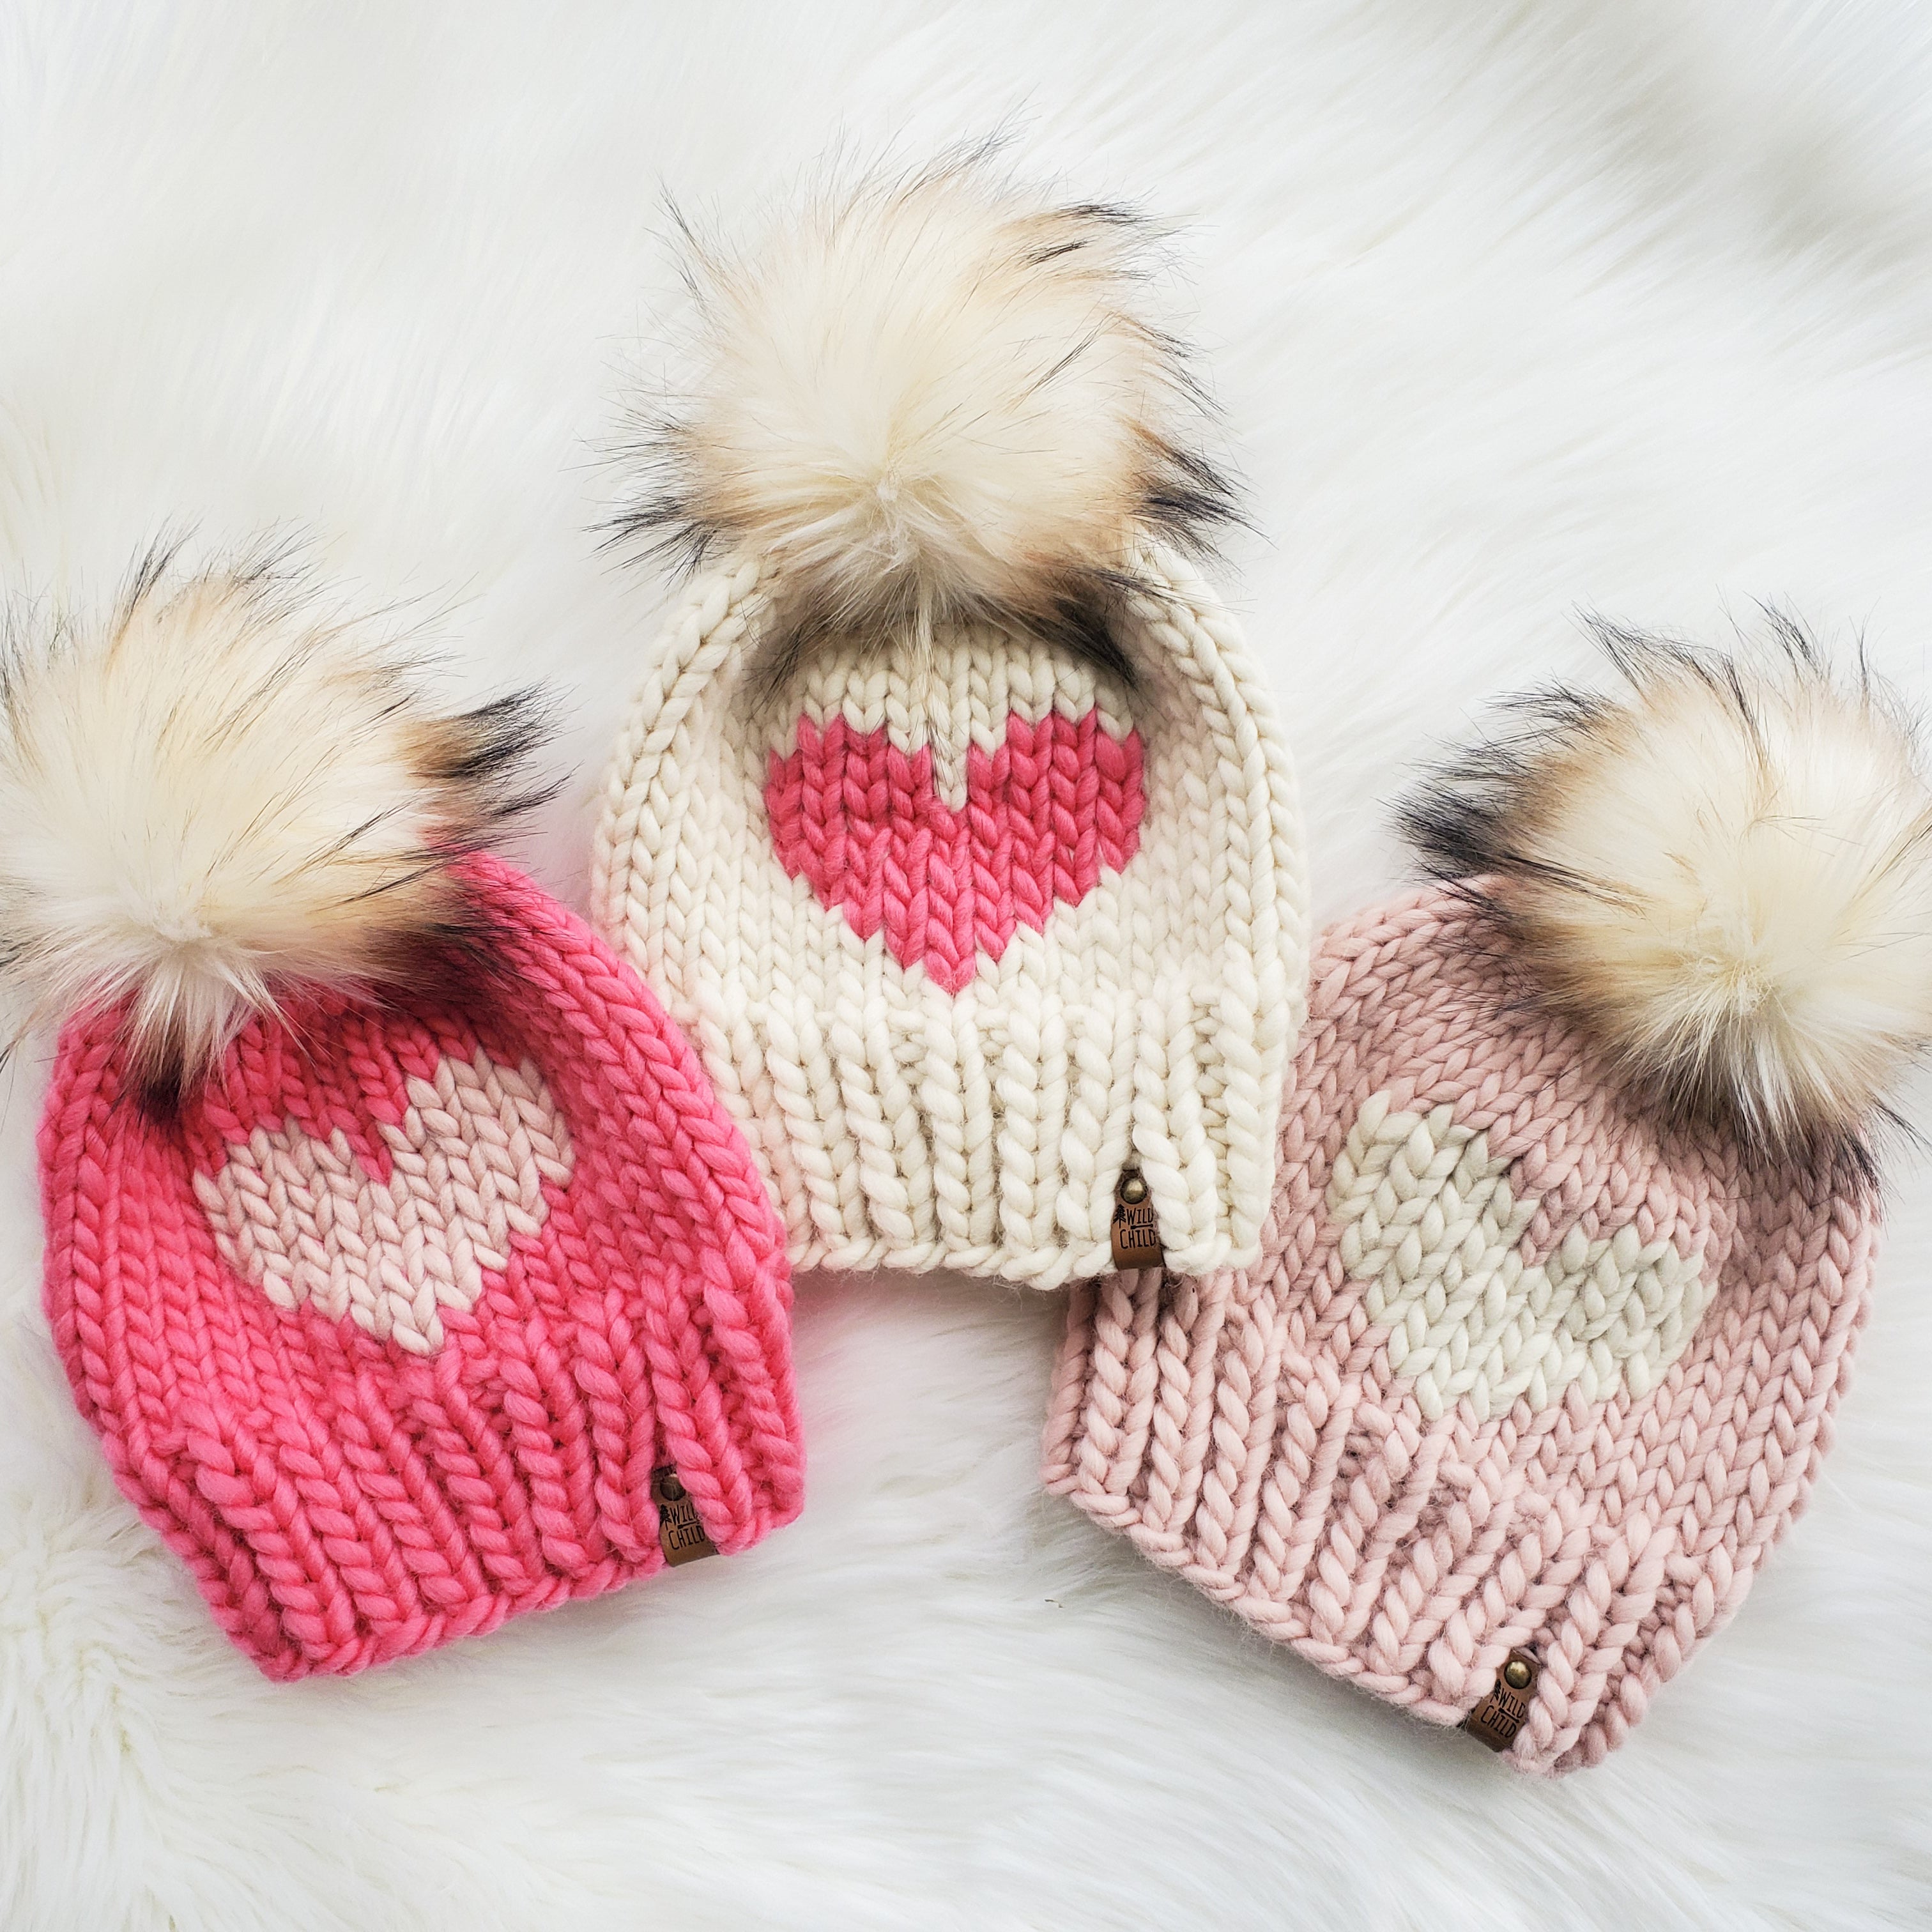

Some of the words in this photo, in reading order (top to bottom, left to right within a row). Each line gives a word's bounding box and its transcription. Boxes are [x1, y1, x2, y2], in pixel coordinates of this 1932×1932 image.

[1126, 1208, 1154, 1225] WILD
[1119, 1229, 1156, 1250] CHILD
[668, 1525, 705, 1551] CHILD
[1498, 1687, 1526, 1719] WILD
[1480, 1705, 1517, 1738] CHILD
